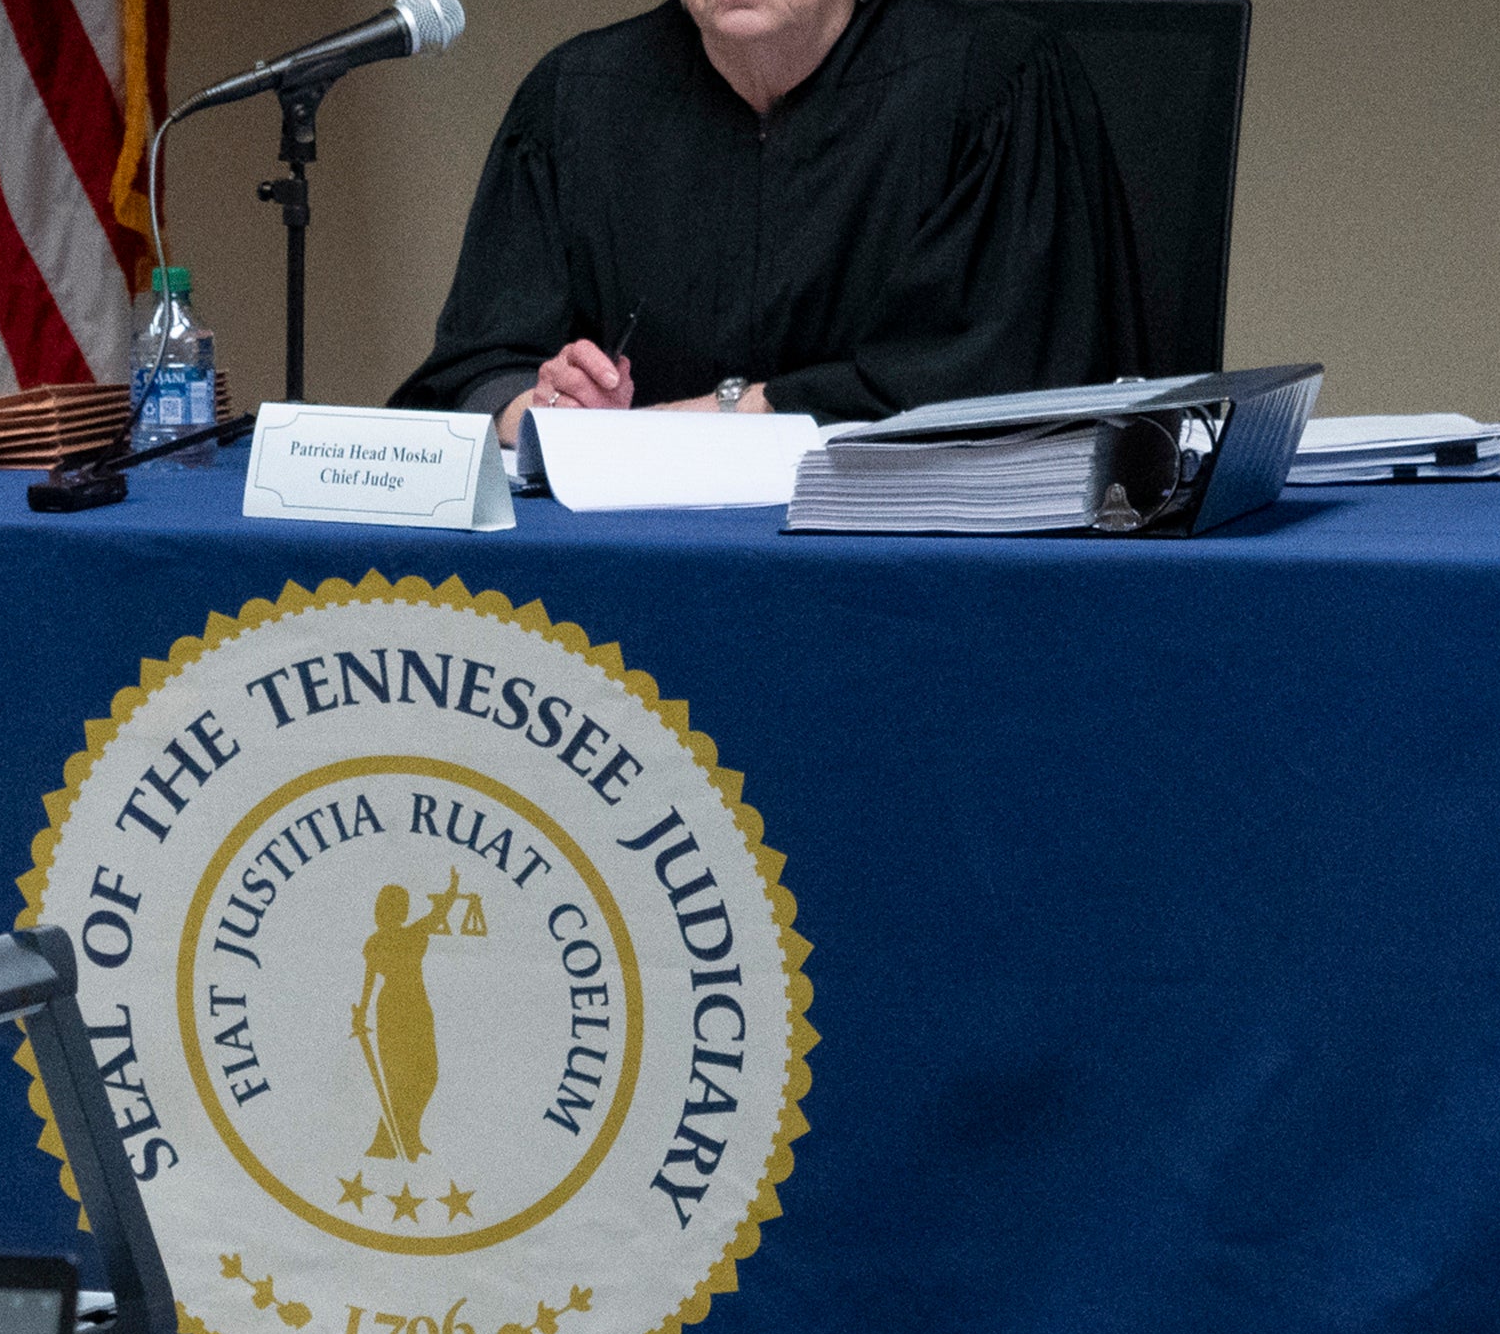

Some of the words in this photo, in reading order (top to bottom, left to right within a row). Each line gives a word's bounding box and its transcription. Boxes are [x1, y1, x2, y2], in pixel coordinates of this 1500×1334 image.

[290, 440, 345, 459] Patricia
[349, 444, 386, 462] Head
[391, 447, 443, 465] Moskal
[320, 467, 359, 485] Chief
[362, 471, 405, 492] Judge
[116, 711, 240, 845] THE
[247, 648, 643, 806] TENNESSEE
[213, 793, 386, 968] JUSTITIA
[409, 793, 552, 891] RUAT
[82, 865, 142, 969] OF
[209, 985, 271, 1108] FIAT
[543, 903, 611, 1136] COELUM
[618, 805, 747, 1230] JUDICIARY
[88, 1003, 179, 1182] SEAL
